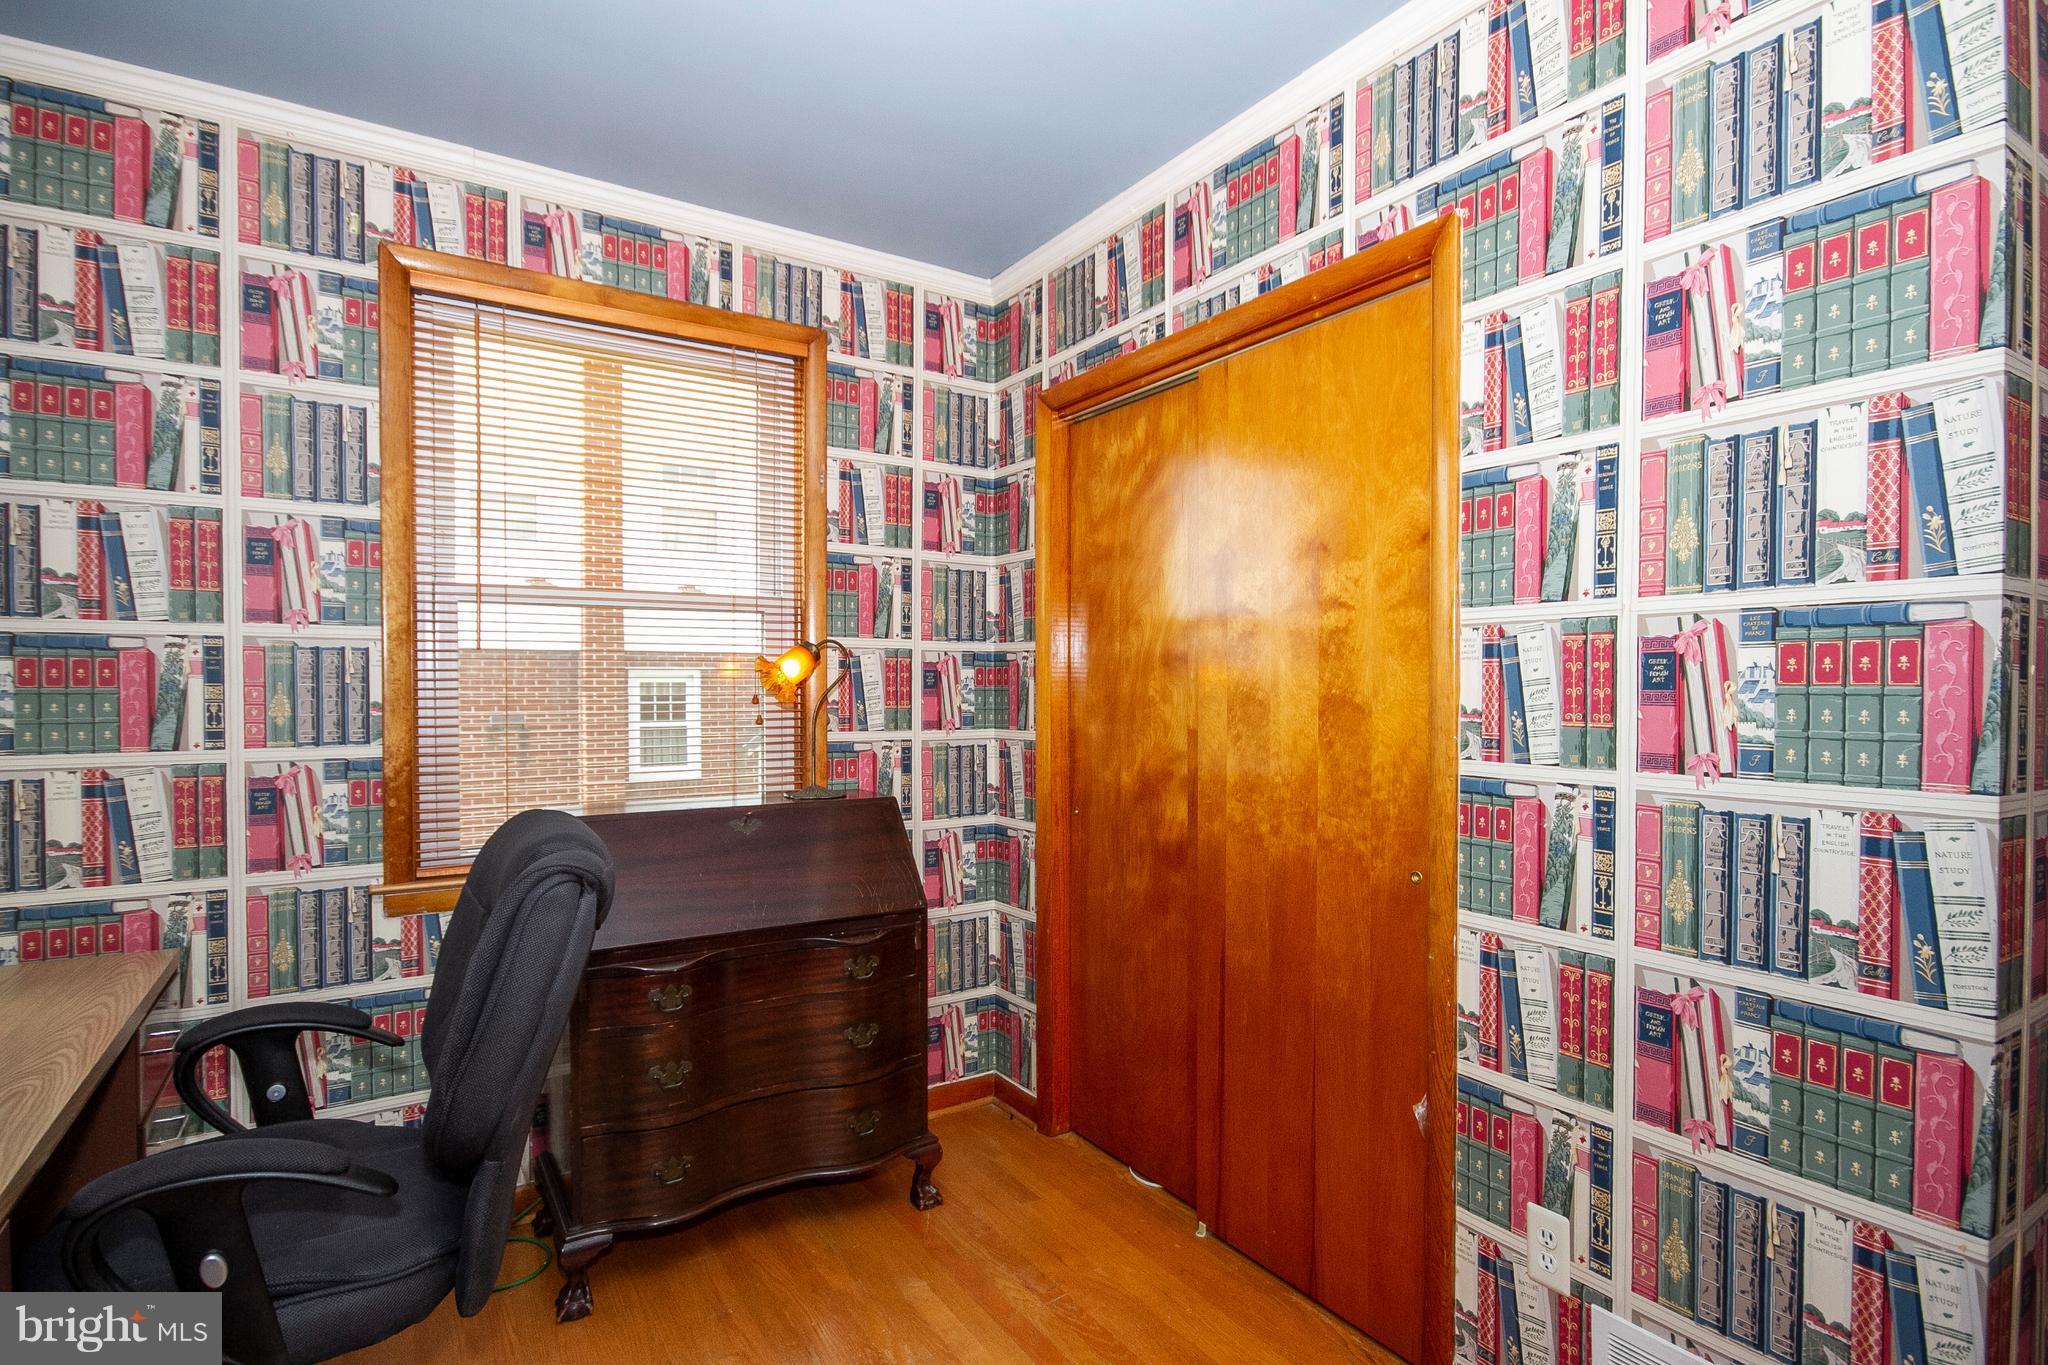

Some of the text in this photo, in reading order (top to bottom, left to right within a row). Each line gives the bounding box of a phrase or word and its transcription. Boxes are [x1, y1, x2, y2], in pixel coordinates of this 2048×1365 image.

[1660, 306, 1670, 314] AND
[1658, 317, 1671, 327] ART
[1829, 416, 1858, 426] TRAVELS
[1944, 409, 1983, 426] NATURE
[1829, 434, 1858, 442] ENGLISH
[1948, 426, 1980, 440] STUDY
[1820, 441, 1864, 452] COUNTRYSIDE
[1962, 541, 2000, 552] COMSTOCK
[1822, 824, 1850, 832] TRAVELS
[1822, 840, 1850, 848] ENGLISH
[1813, 848, 1856, 857] COUNTRYSIDE
[1935, 851, 1973, 860] NATURE
[1939, 866, 1972, 875] STUDY
[1952, 984, 1990, 992] COMSTOCK
[1648, 1030, 1662, 1038] ART
[1815, 1220, 1843, 1236] TRAVELS
[1828, 1234, 1840, 1242] THE
[1815, 1238, 1843, 1252] ENGLISH
[1808, 1244, 1848, 1262] COUNTRYSIDE
[1925, 1278, 1962, 1294] NATURE
[1928, 1294, 1960, 1309] STUDY
